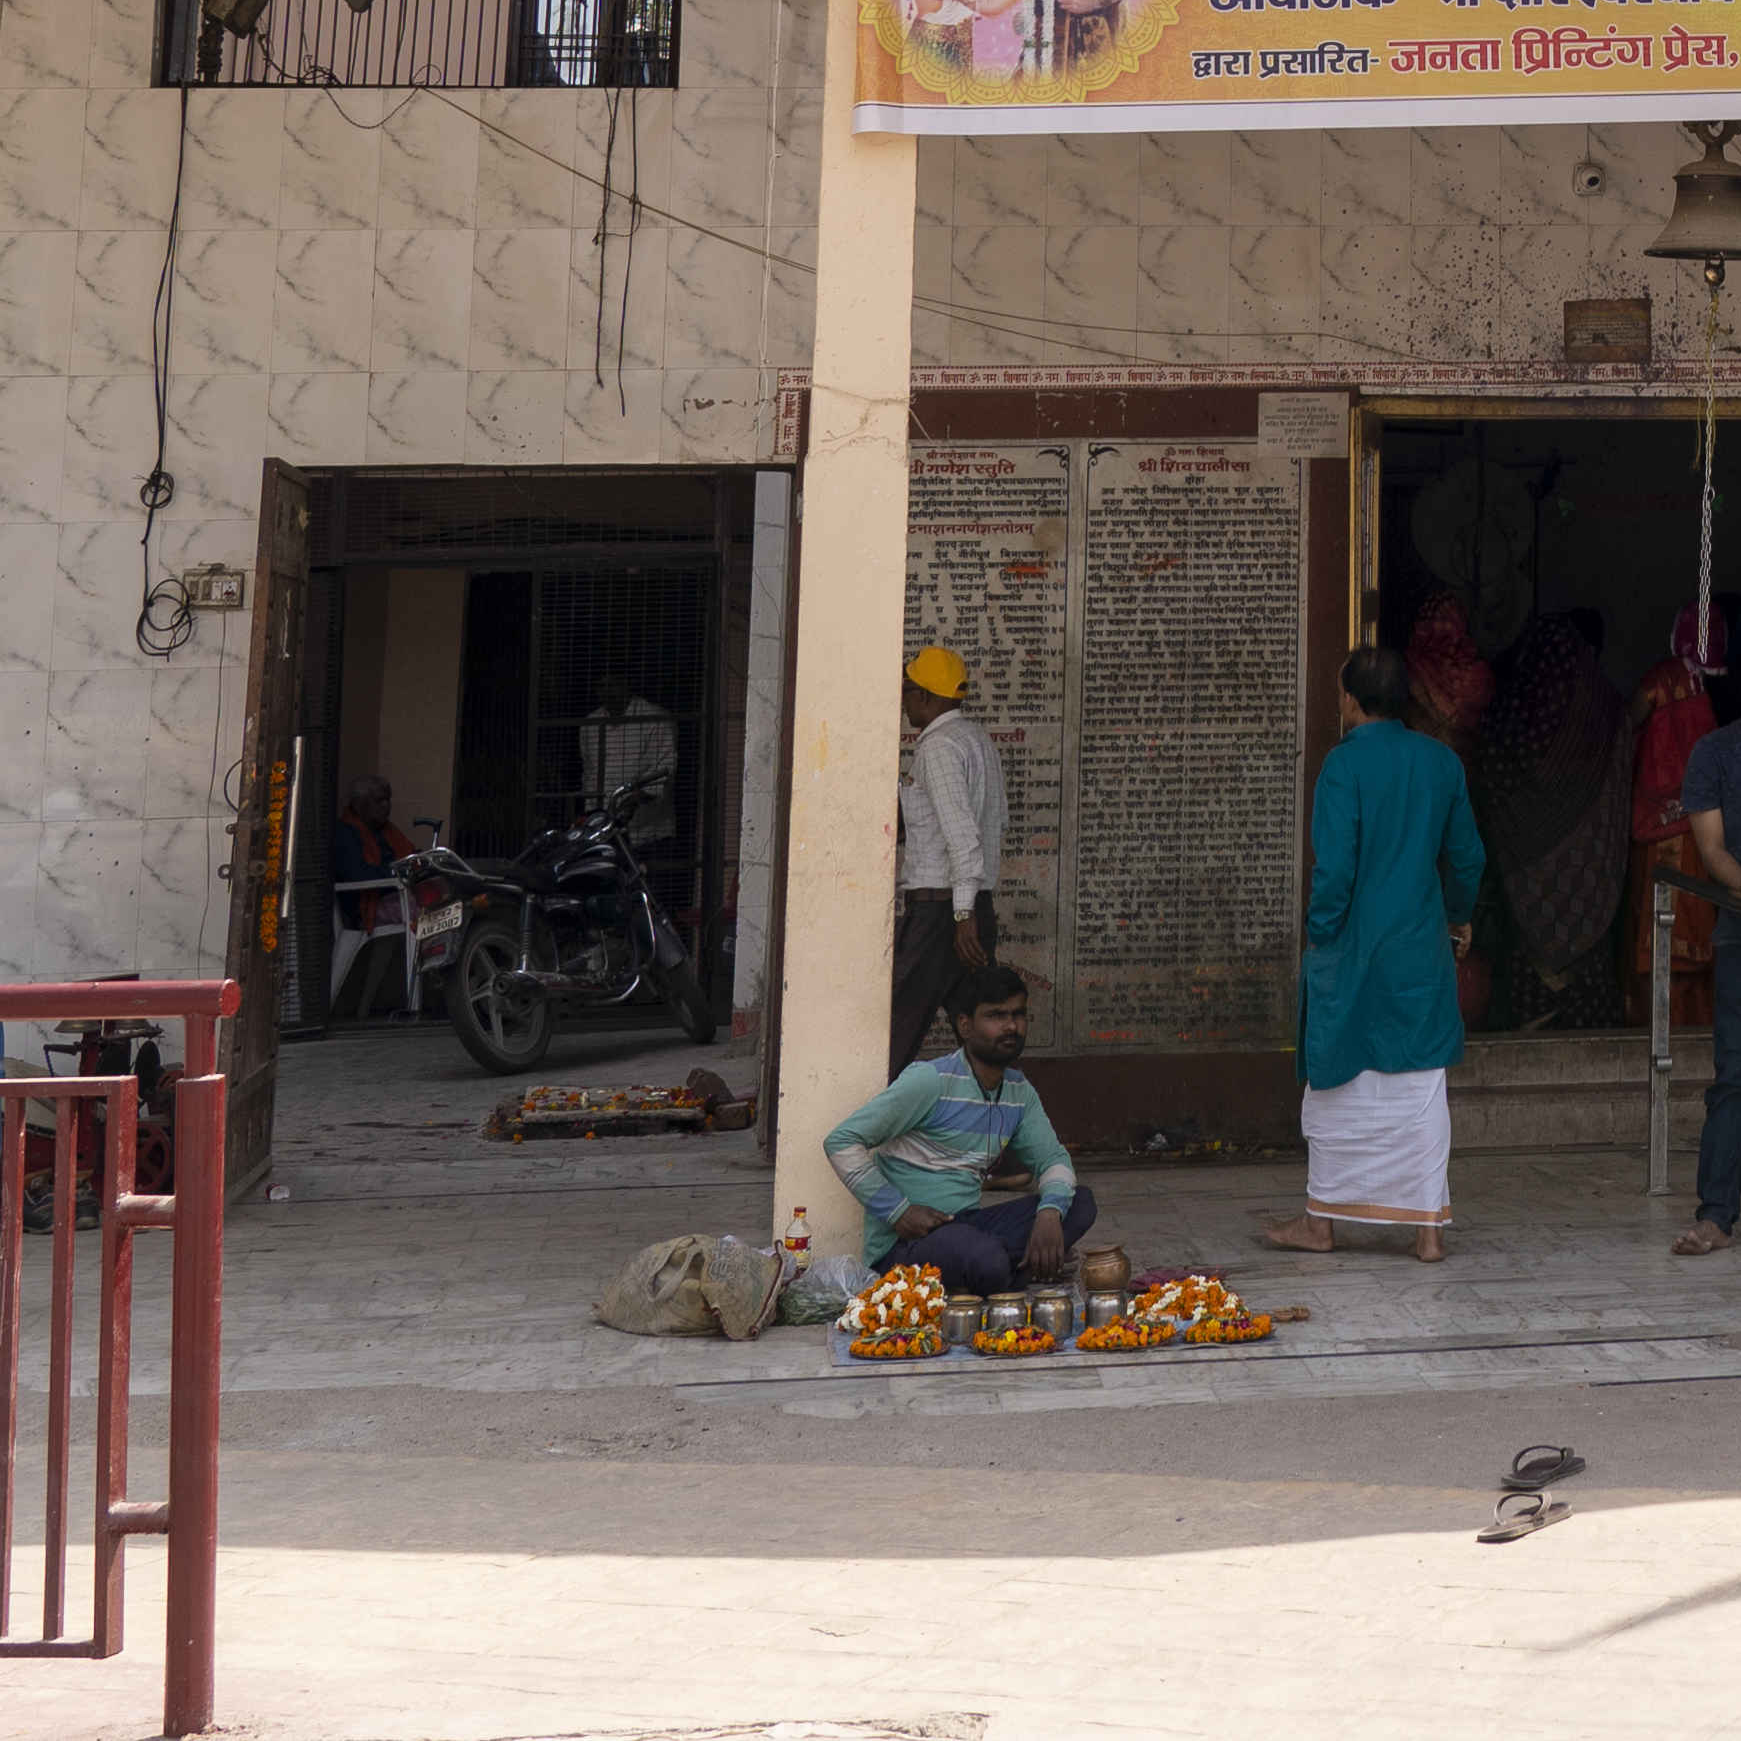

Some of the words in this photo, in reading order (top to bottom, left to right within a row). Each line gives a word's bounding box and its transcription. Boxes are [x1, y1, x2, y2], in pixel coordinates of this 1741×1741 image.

[1191, 50, 1252, 78] द्वारा
[1259, 41, 1380, 78] प्रसारित-
[1389, 39, 1502, 73] जनता
[1511, 25, 1653, 75] प्रिन्टिंग
[1662, 25, 1740, 72] प्रेस,
[1138, 459, 1157, 473] श्री
